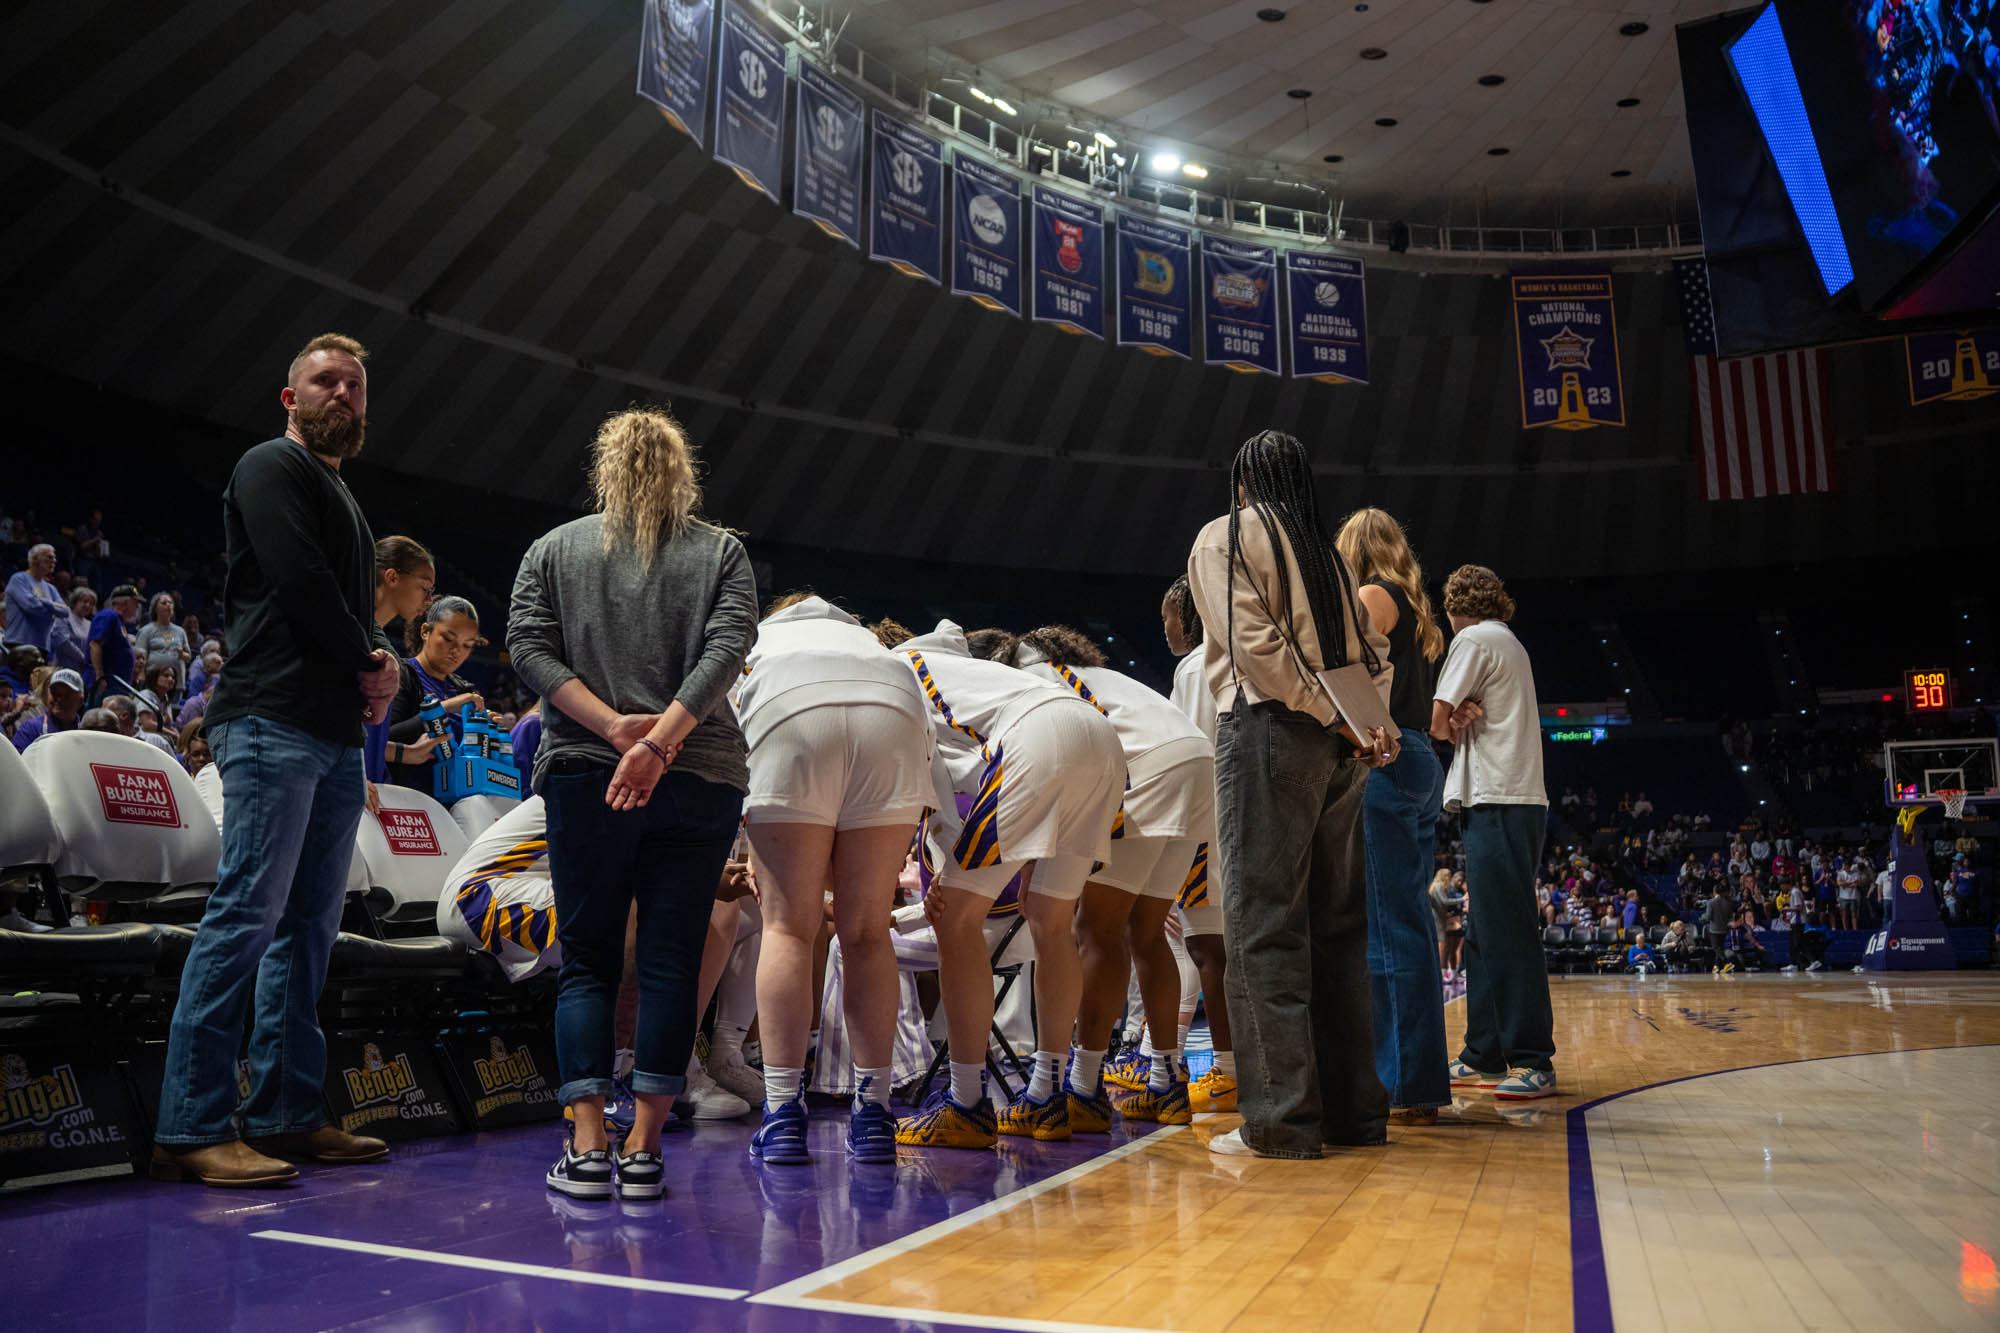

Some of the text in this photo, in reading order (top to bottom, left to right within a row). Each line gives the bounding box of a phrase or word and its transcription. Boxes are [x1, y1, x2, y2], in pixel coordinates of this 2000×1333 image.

[739, 50, 768, 99] SEC
[816, 105, 844, 151] SEC
[892, 151, 923, 194] SEC
[973, 214, 1005, 236] NCAA
[966, 252, 1009, 277] FINAL FOUR
[972, 267, 1003, 291] 1953
[1047, 280, 1091, 303] FINAL FOUR
[1215, 286, 1256, 300] FOUR
[1055, 296, 1083, 317] 1981
[1132, 305, 1178, 325] FINAL FOUR
[1541, 302, 1587, 312] NATIONAL
[1138, 318, 1172, 339] 1986
[1305, 313, 1352, 327] NATIONAL
[1528, 311, 1602, 326] CHAMPIONS
[1218, 324, 1265, 341] FINAL FOUR
[1300, 322, 1358, 338] CHAMPIONS
[1223, 336, 1260, 356] 2006
[1921, 351, 2000, 380] 20 2
[1533, 386, 1612, 406] 20 23
[1913, 673, 1945, 686] 10:00
[1915, 686, 1944, 708] 30
[1557, 730, 1592, 741] Federal
[117, 773, 163, 791] FARM
[487, 769, 518, 789] POWERADE
[104, 785, 169, 806] BUREAU
[119, 806, 173, 820] INSURANCE
[392, 814, 427, 828] FARM
[386, 825, 431, 840] BUREAU
[398, 840, 435, 850] INSURANCE
[1901, 937, 1945, 946] Equipment
[1901, 944, 1925, 952] Share
[477, 1047, 535, 1091] Bengal
[346, 1055, 413, 1104] Bengal
[527, 1076, 546, 1091] .com
[404, 1088, 426, 1105] .com
[59, 1107, 95, 1131] .com
[400, 1102, 447, 1120] G.O.N.E.
[49, 1125, 127, 1149] G.O.N.E.
